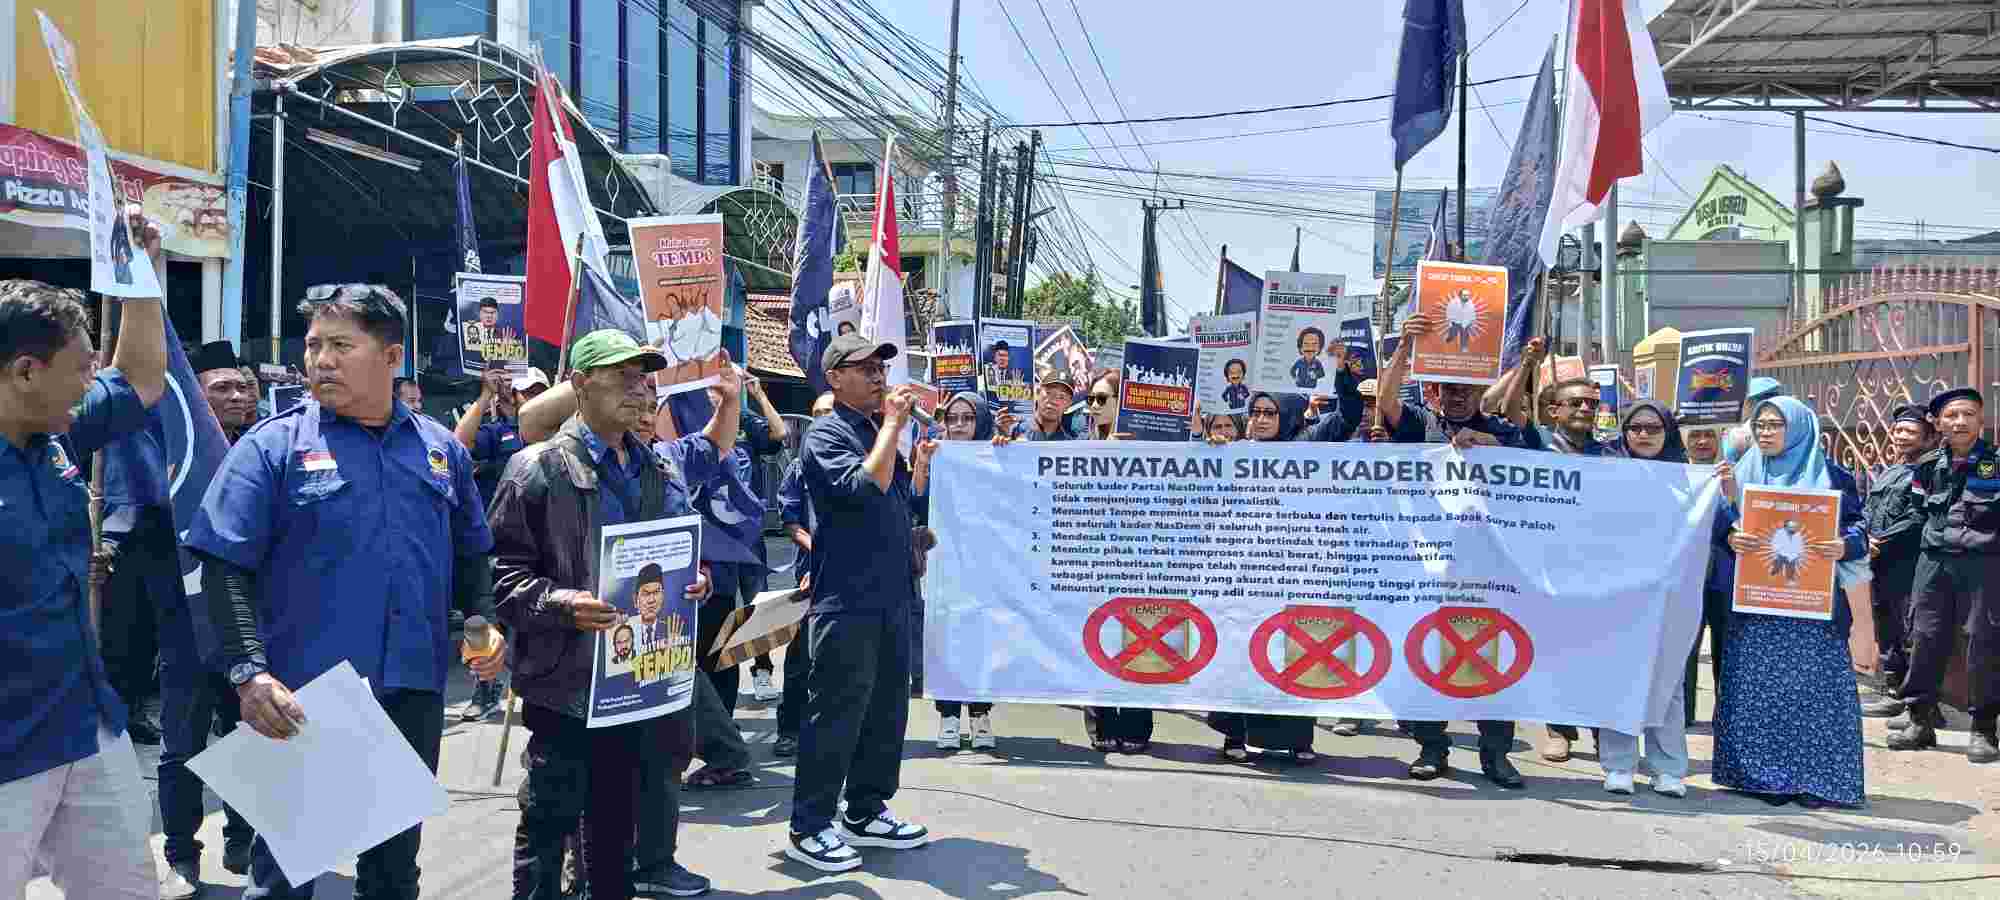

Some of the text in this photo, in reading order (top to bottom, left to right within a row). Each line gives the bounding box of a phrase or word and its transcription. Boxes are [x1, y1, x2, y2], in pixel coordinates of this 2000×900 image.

[5, 180, 64, 207] Pizza
[655, 248, 714, 267] TEMPO
[1269, 294, 1304, 305] BREAKING
[1037, 456, 1582, 492] PERNYATAAN SIKAP KADER NASDEM
[1052, 480, 1094, 492] Seluruh
[1097, 480, 1128, 492] kader
[1131, 480, 1164, 492] Partai
[1168, 481, 1214, 492] NasDem
[1217, 482, 1275, 494] keberatan
[1278, 484, 1303, 495] atas
[1307, 484, 1383, 498] pemberitaan
[1386, 486, 1426, 498] Tempo
[1430, 488, 1459, 498] yang
[1464, 486, 1491, 498] tidak
[1052, 493, 1080, 504] tidak
[1083, 493, 1150, 507] menjunjung
[1153, 494, 1187, 507] tinggi
[1190, 494, 1219, 506] etika
[1032, 504, 1555, 531] 2. Menuntut Tempo meminta maaf secara terbuka dan tertulis kepada Bapak Surya Paloh
[1052, 518, 1073, 529] dan
[1075, 518, 1117, 530] seluruh
[1120, 519, 1152, 530] kader
[1155, 519, 1201, 531] NasDem
[1204, 520, 1216, 532] di
[1219, 521, 1262, 532] seluruh
[1265, 522, 1312, 535] penjuru
[1315, 523, 1350, 534] tanah
[1032, 530, 1453, 550] 3. Mendesak Dewan Pers untuk segera bertindak tegas terhadap Tempo
[1032, 542, 1040, 554] 4.
[1051, 543, 1100, 554] Meminta
[1103, 544, 1134, 557] pihak
[1138, 545, 1175, 556] terkait
[1178, 548, 1244, 559] memproses
[1247, 548, 1284, 559] sanksi
[1326, 550, 1368, 563] hingga
[1051, 556, 1379, 577] karena pemberitaan tempo telah mencederai fungsi pers
[1051, 569, 1094, 582] sebagai
[1096, 570, 1144, 583] pemberi
[1146, 571, 1201, 583] informasi
[1204, 575, 1232, 586] yang
[1236, 574, 1274, 586] akurat
[1277, 575, 1299, 586] dan
[1302, 576, 1376, 590] menjunjung
[1379, 578, 1416, 591] tinggi
[1031, 580, 1040, 592] 5.
[1050, 582, 1105, 593] Menuntut
[1108, 586, 1146, 597] proses
[1149, 584, 1188, 595] hukum
[1191, 587, 1220, 598] yang
[1223, 586, 1244, 597] adil
[1247, 587, 1285, 598] sesuai
[1414, 592, 1440, 603] yang
[631, 646, 692, 684] TEMPO
